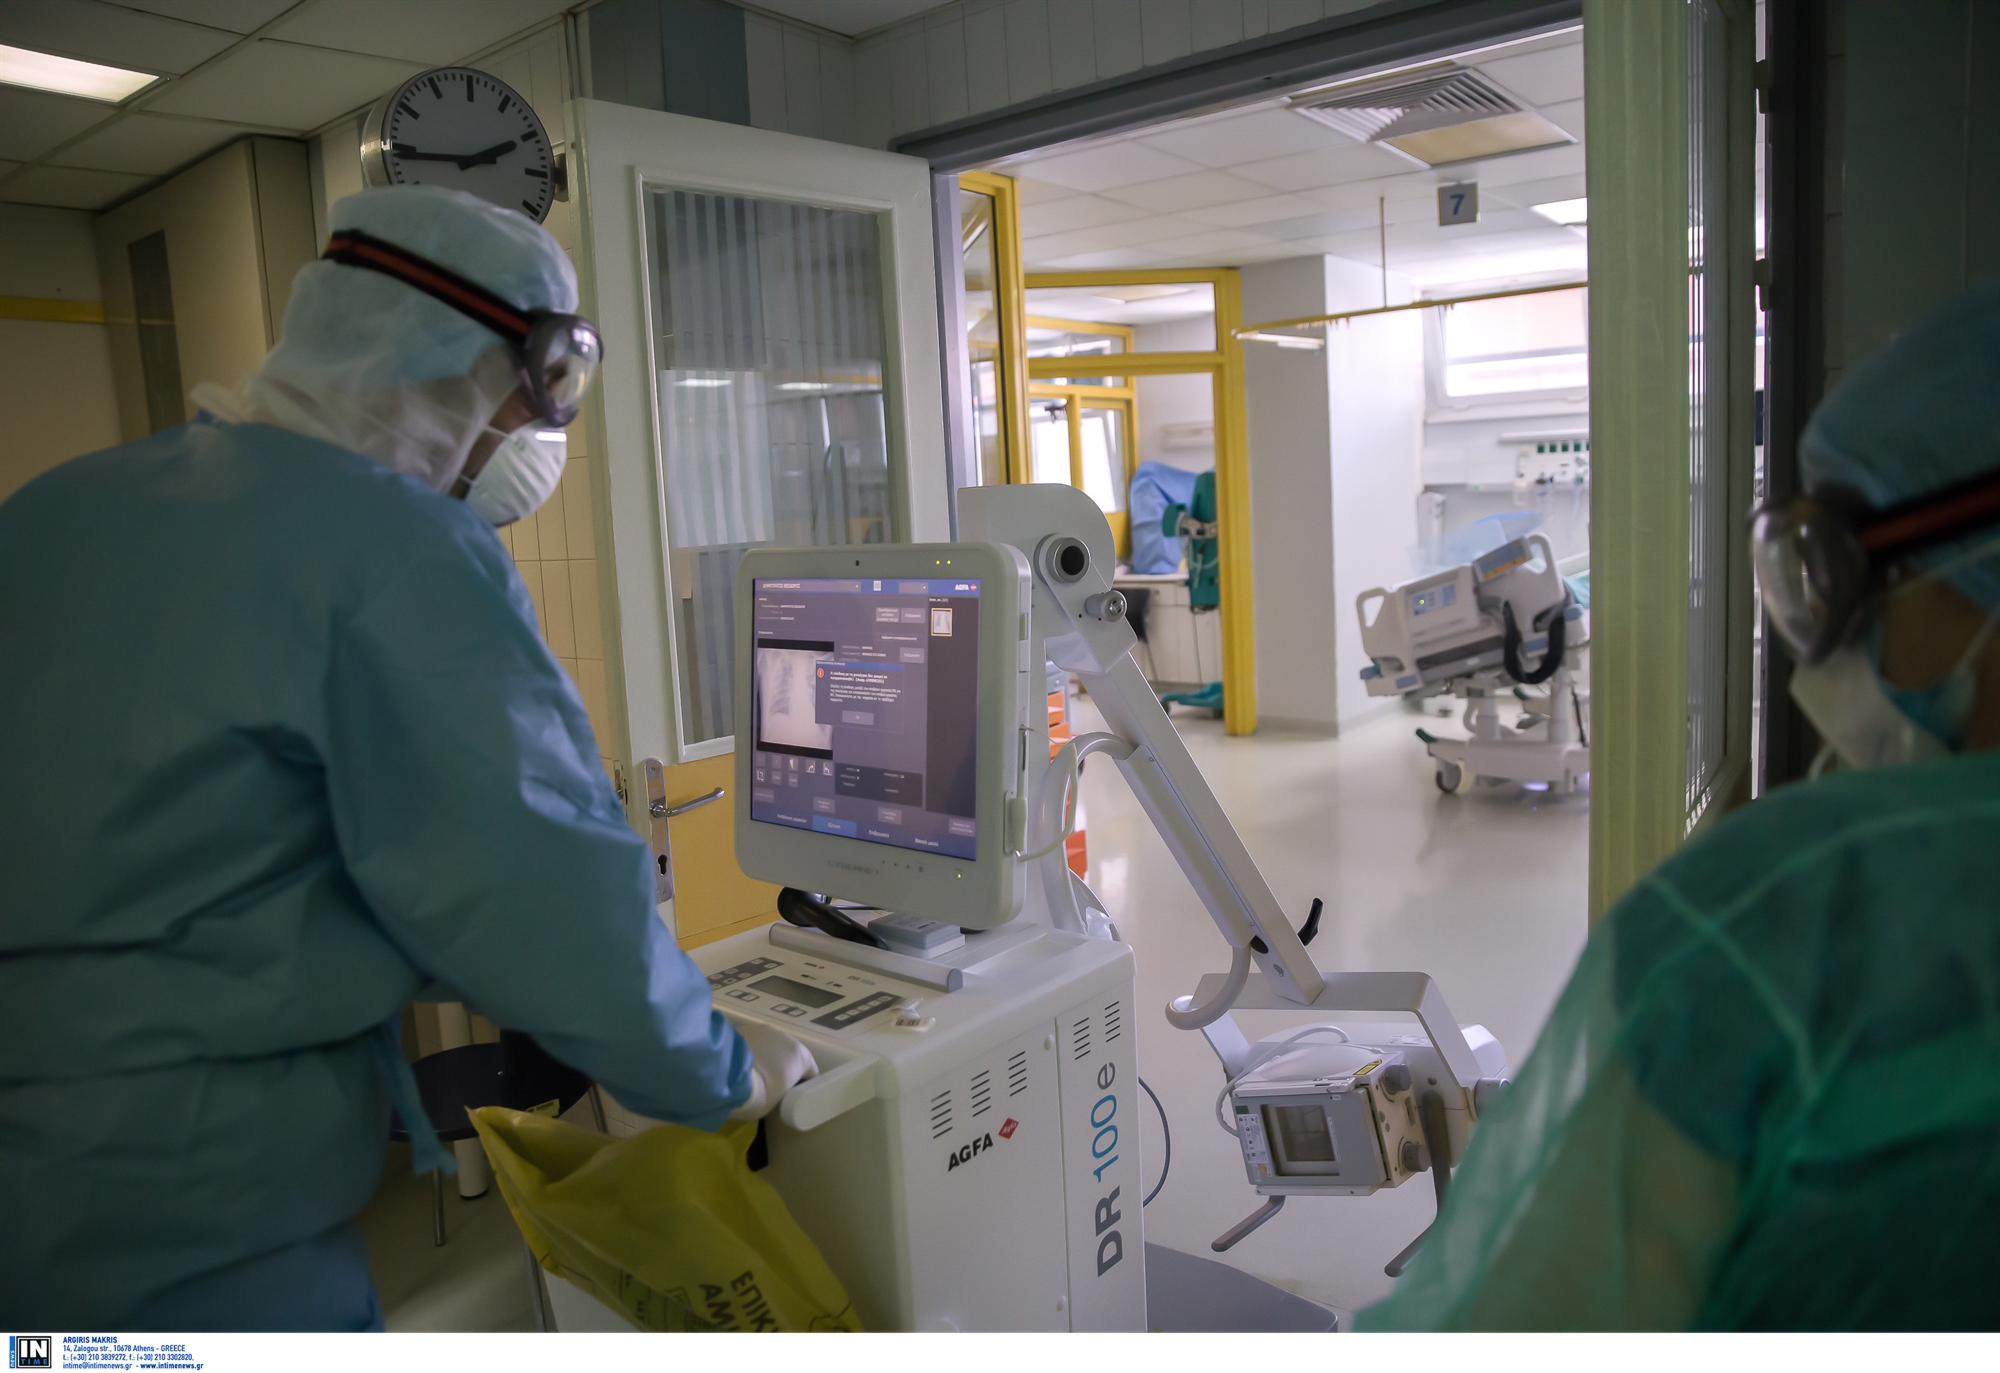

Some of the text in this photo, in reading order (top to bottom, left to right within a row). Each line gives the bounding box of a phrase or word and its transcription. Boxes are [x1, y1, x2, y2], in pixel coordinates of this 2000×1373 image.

[1449, 193, 1466, 216] 7
[827, 859, 880, 876] CYBERNET
[948, 1132, 994, 1172] AGFA
[1095, 1185, 1124, 1278] DR
[730, 1270, 780, 1333] ΕΠΙΚ
